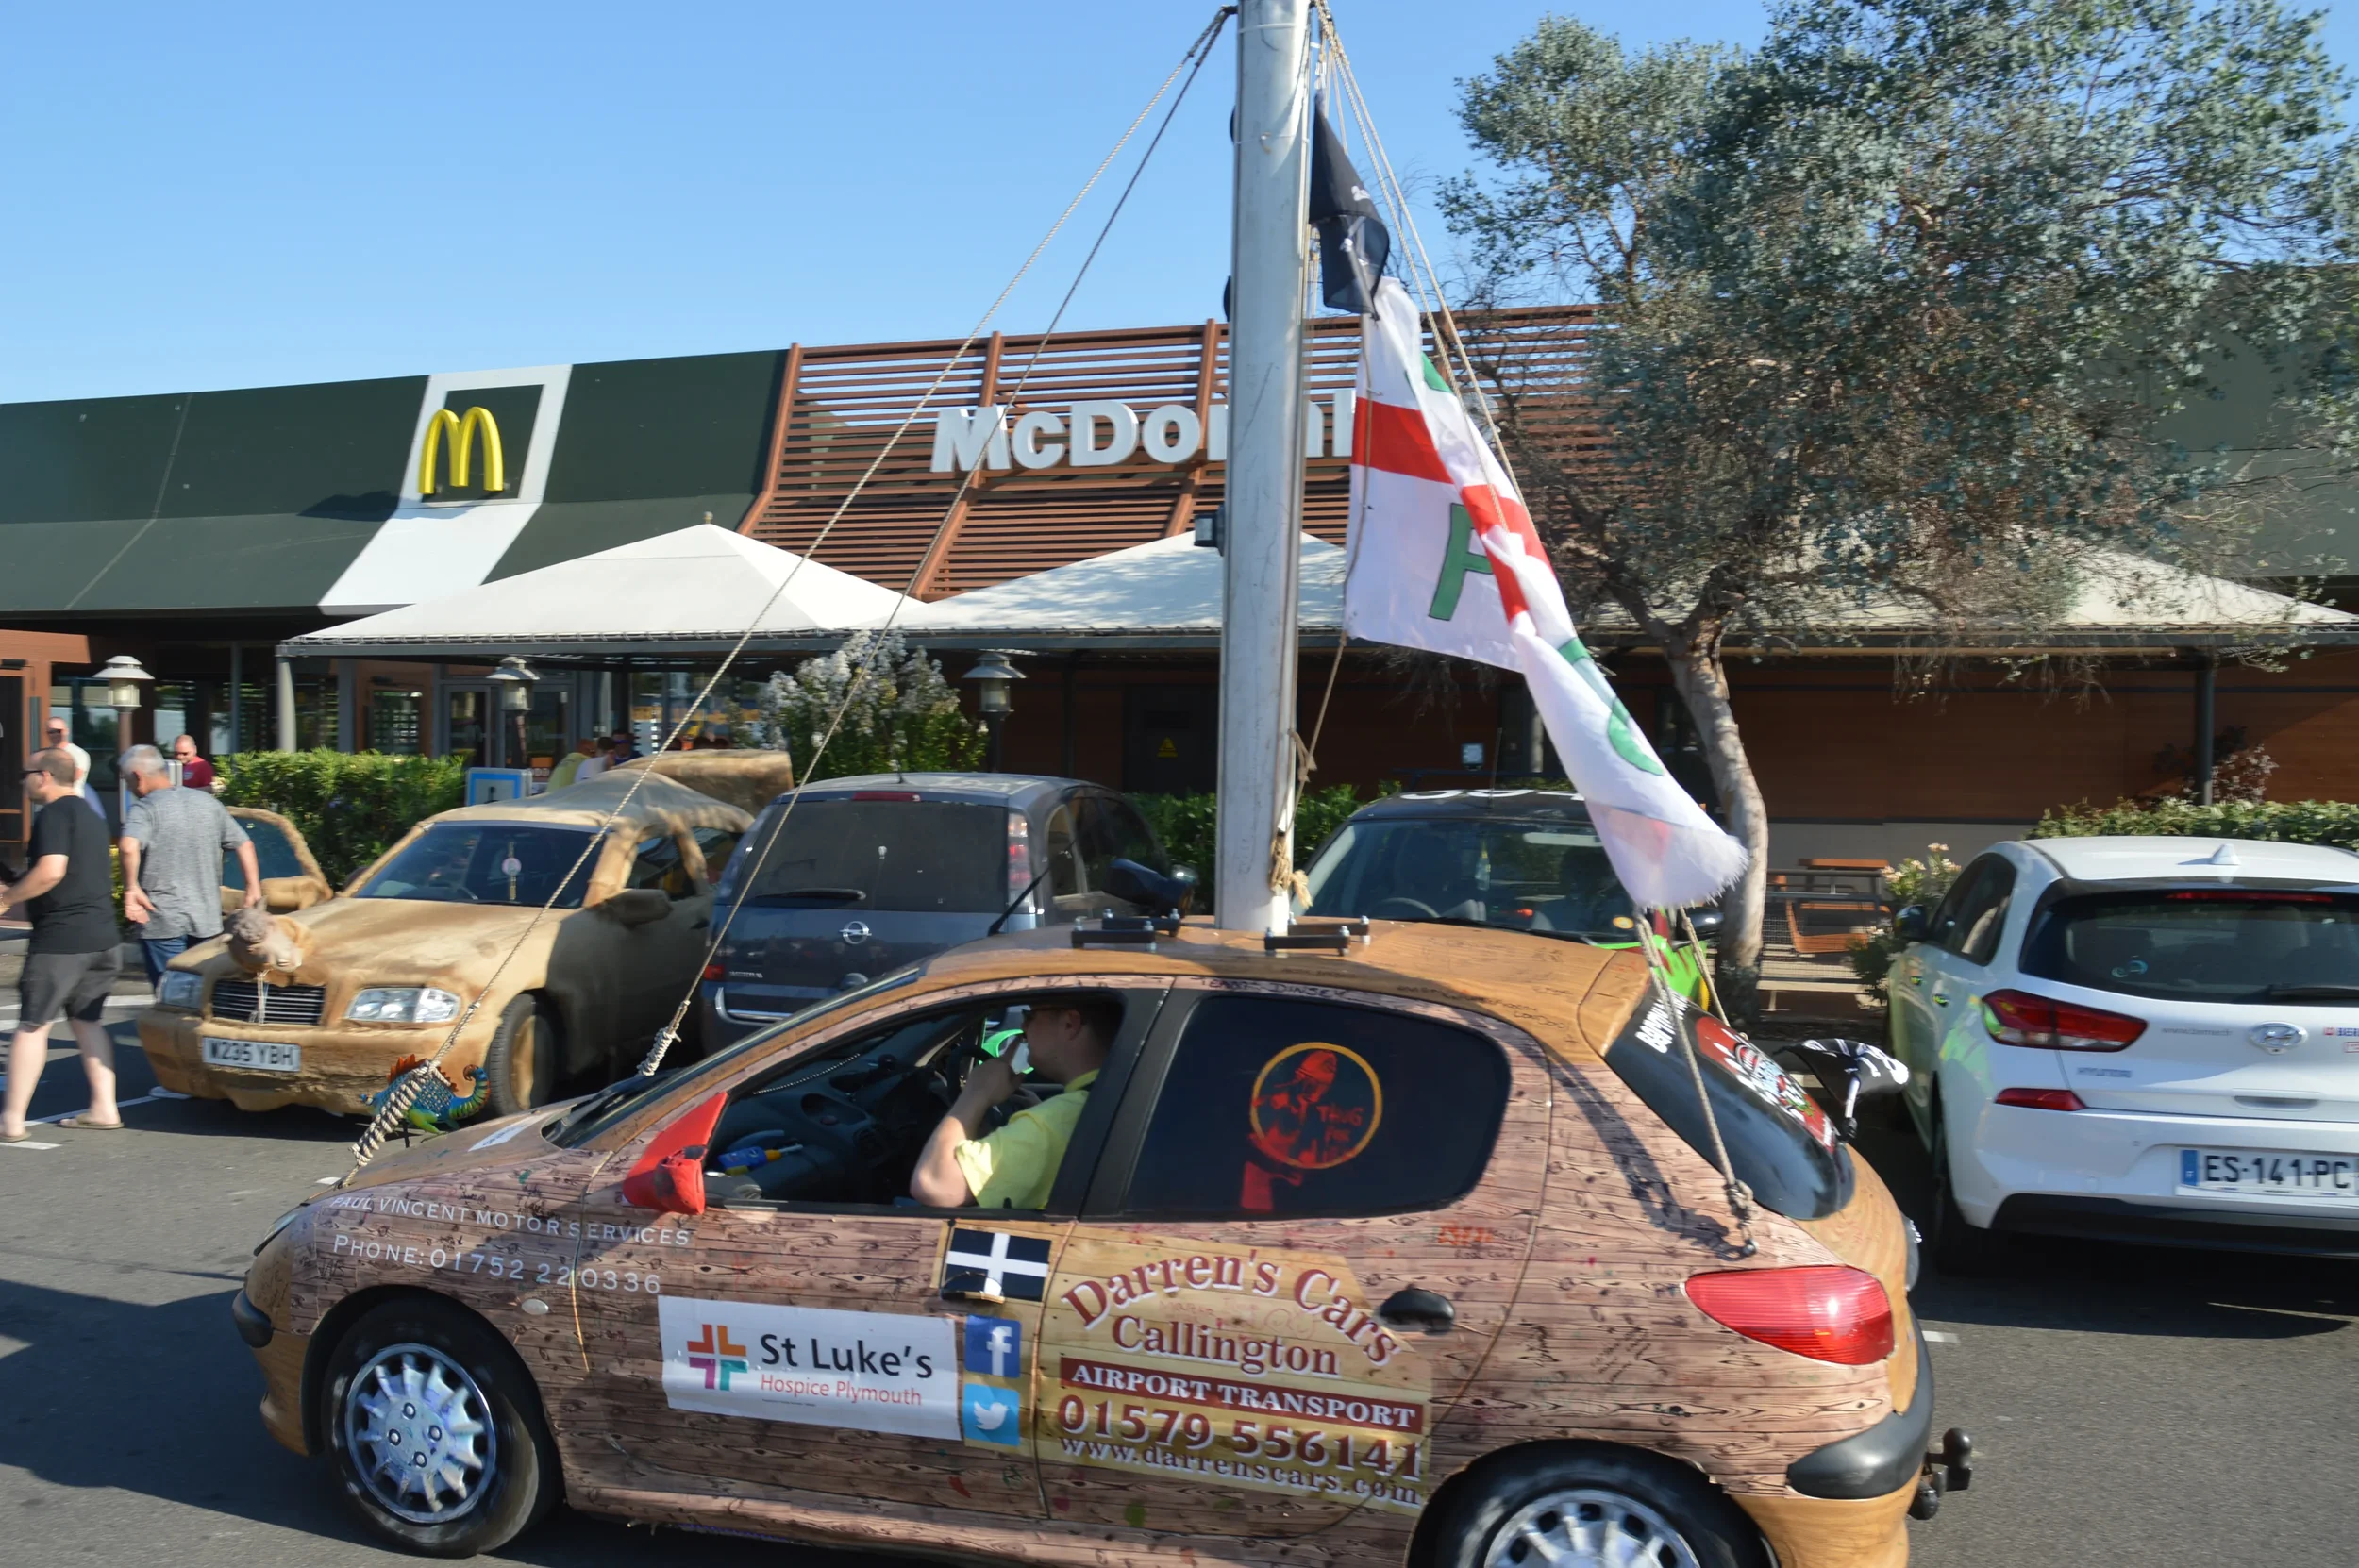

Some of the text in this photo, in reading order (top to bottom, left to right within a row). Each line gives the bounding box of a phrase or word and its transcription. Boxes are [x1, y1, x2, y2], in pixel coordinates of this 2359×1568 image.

[417, 406, 504, 494] M
[331, 1195, 691, 1246] PAUL VINCENT MOTOR SERVICES
[535, 1262, 661, 1295] 220336
[1061, 1249, 1281, 1329] Darren's
[1293, 1268, 1400, 1366] Cars
[760, 1333, 933, 1379] St Luke's
[1112, 1314, 1341, 1376] Callington
[761, 1374, 922, 1407] Hospice Plymouth
[1071, 1363, 1415, 1427] AIRPORT TRANSPORT
[1057, 1393, 1422, 1483] 01579 556141
[1058, 1436, 1422, 1508] www.darrenscars.com
